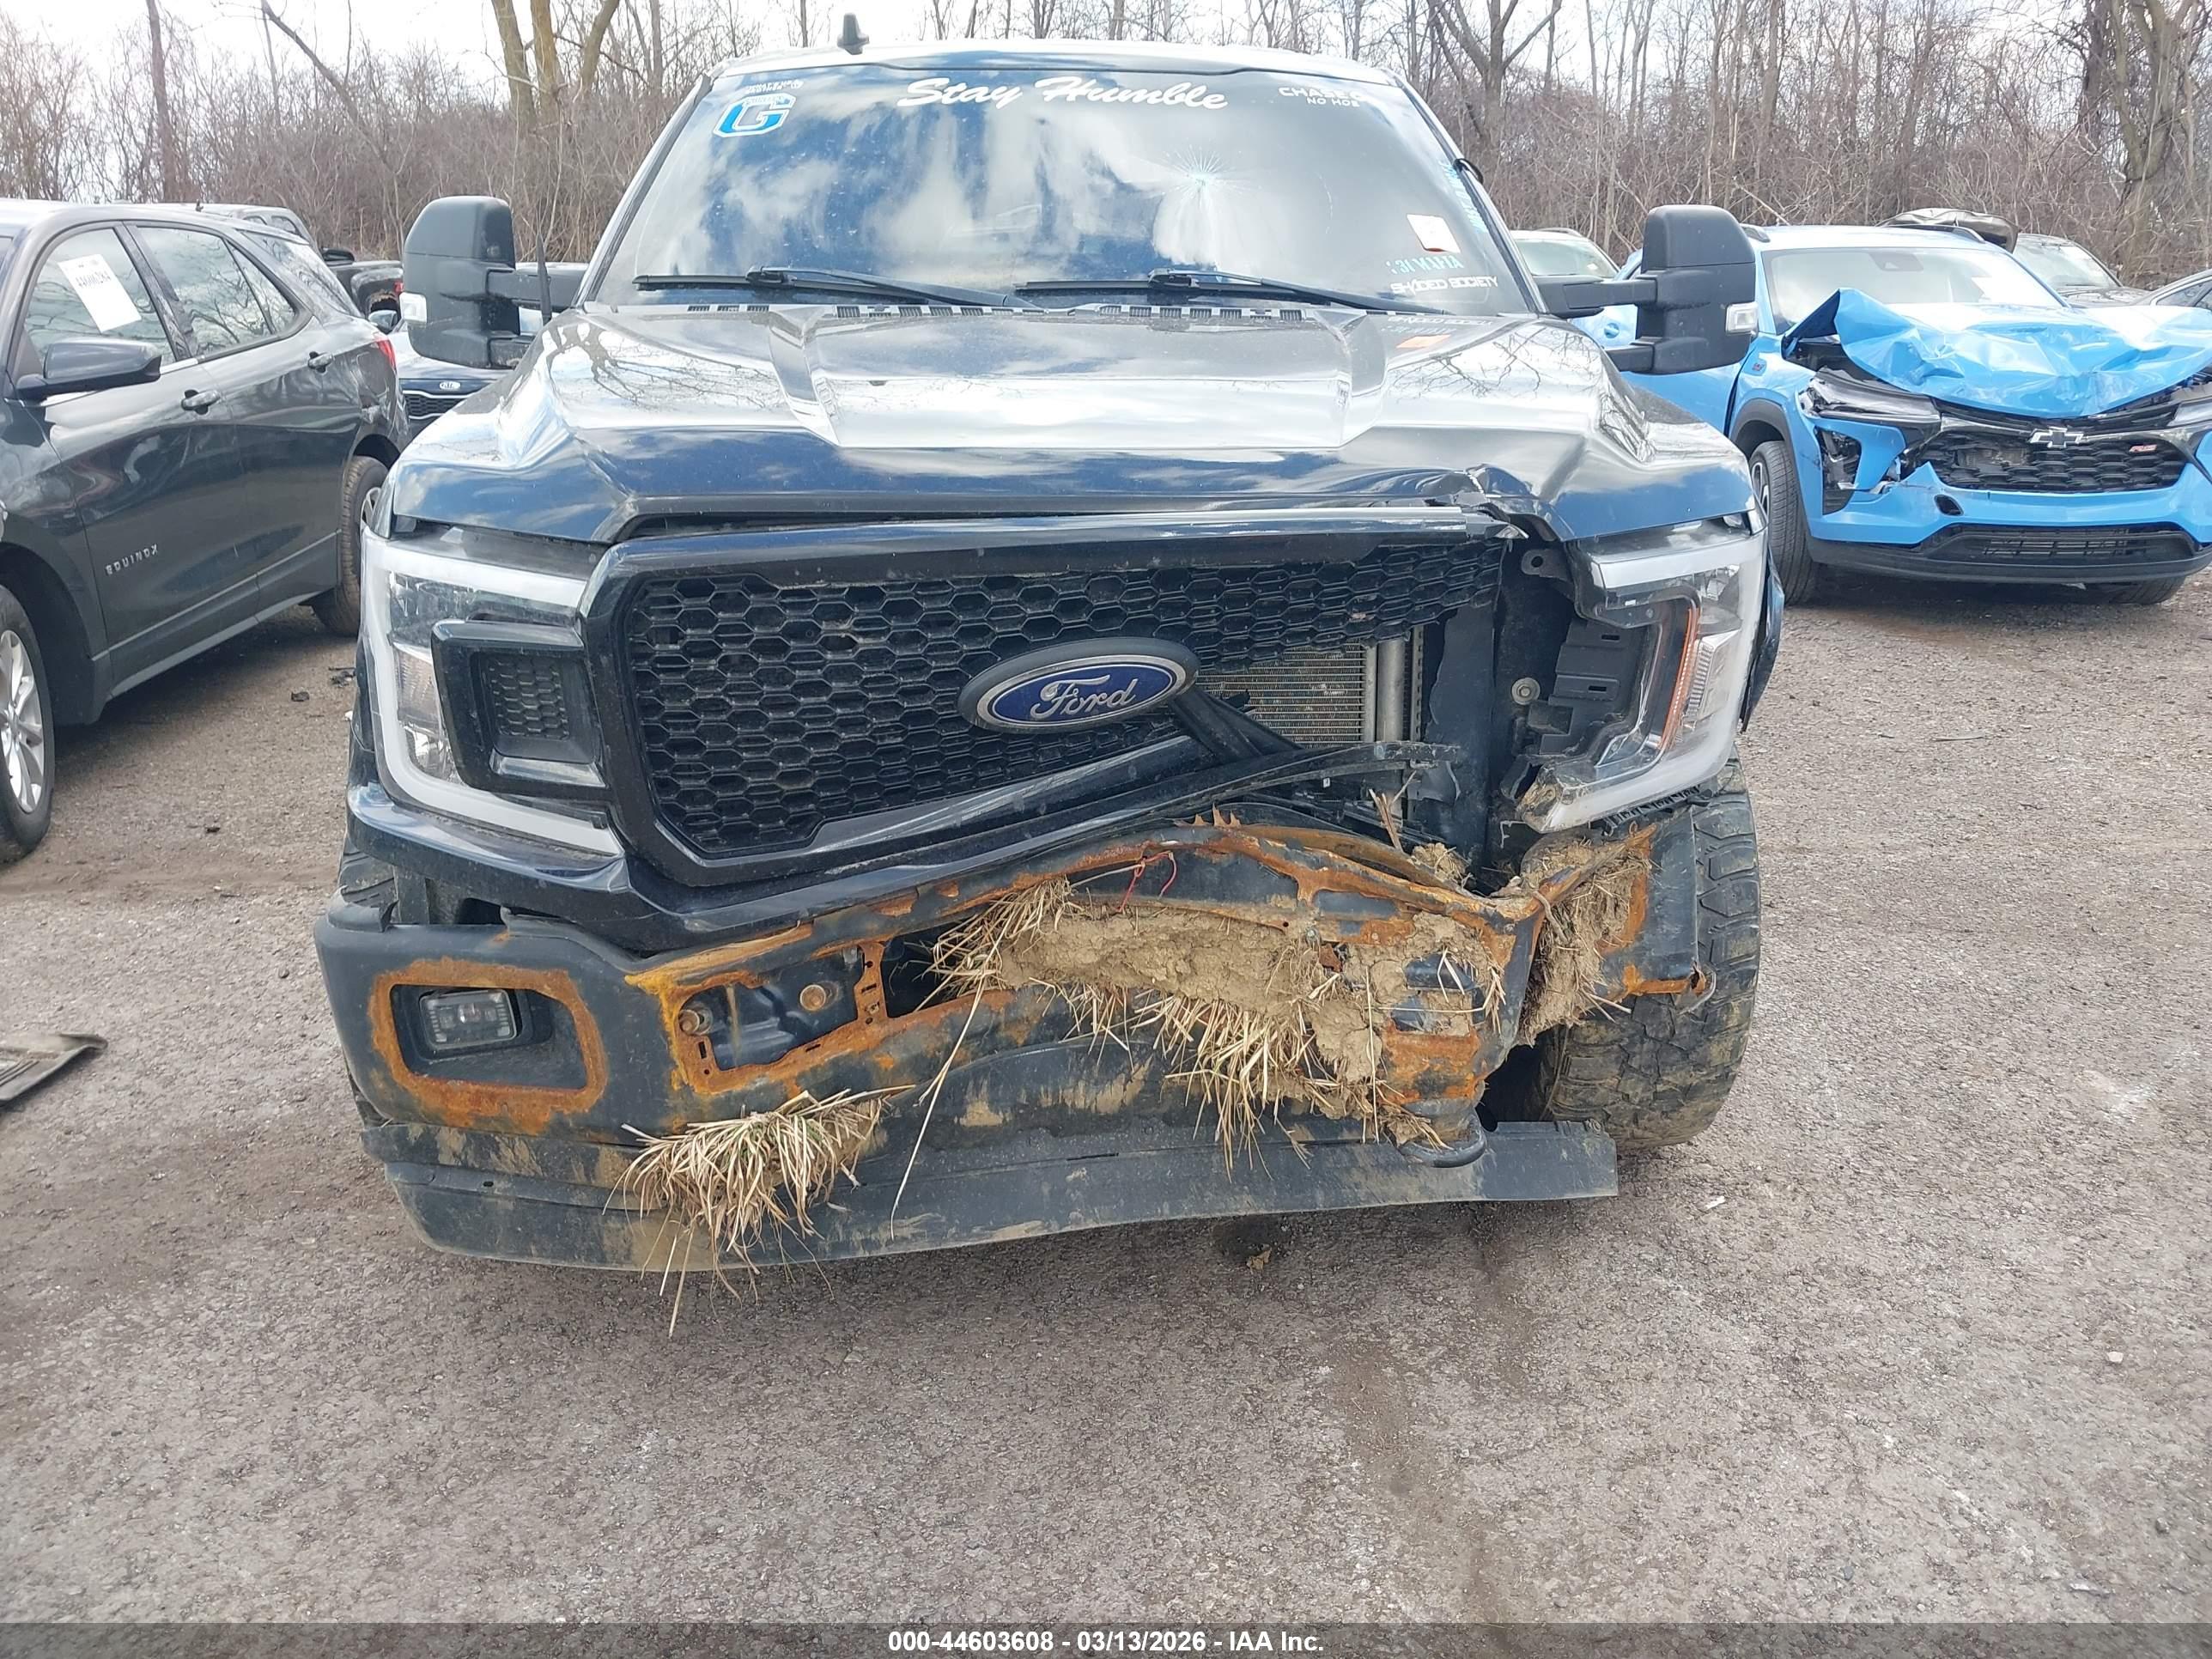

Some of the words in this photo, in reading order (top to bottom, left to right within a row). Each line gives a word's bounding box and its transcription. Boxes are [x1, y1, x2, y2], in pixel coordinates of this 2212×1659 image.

[897, 77, 1023, 109] Stay
[1035, 76, 1229, 110] Humble
[1449, 276, 1498, 289] SOCIETY
[106, 544, 158, 575] EQUINOX
[1030, 673, 1139, 720] Ford
